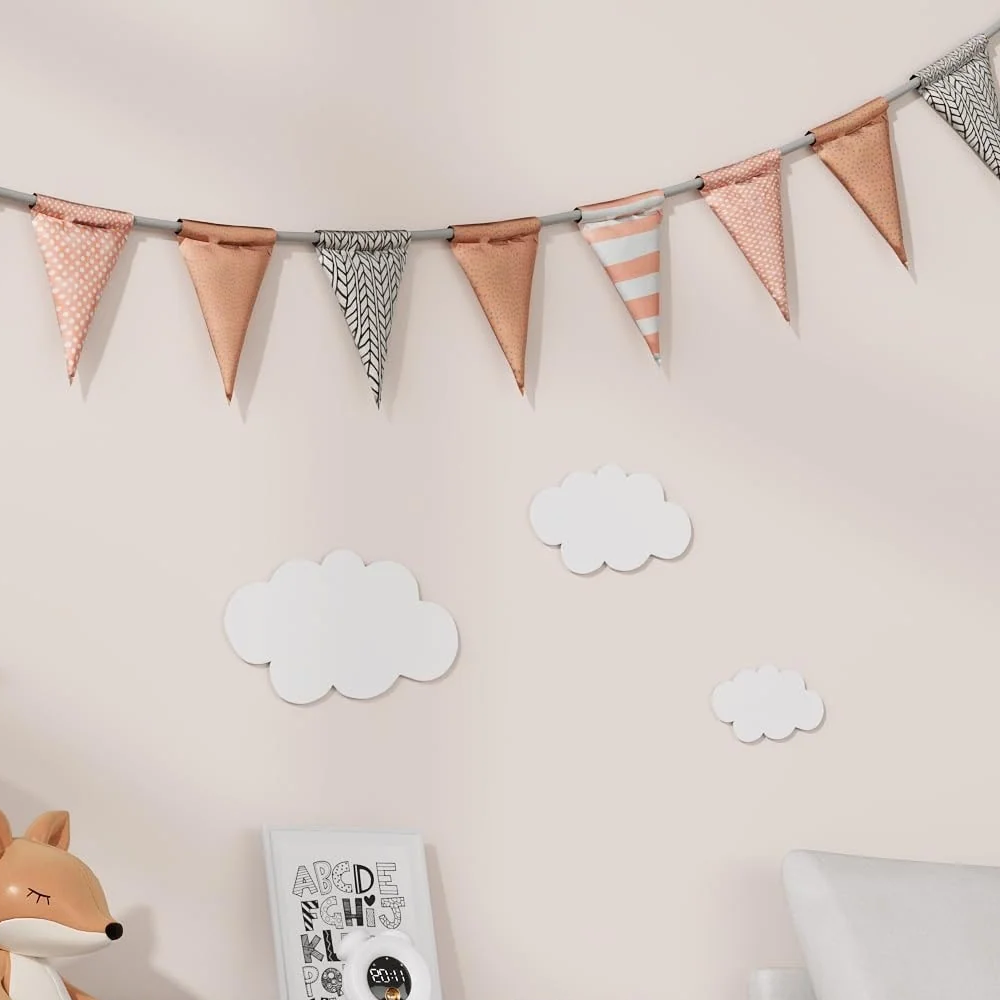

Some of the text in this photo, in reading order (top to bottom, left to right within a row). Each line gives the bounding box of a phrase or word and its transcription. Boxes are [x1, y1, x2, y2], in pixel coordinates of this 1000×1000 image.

[292, 860, 399, 897] ABCDE
[300, 929, 348, 964] KL
[302, 963, 345, 998] PQ
[369, 968, 406, 983] 20:11
